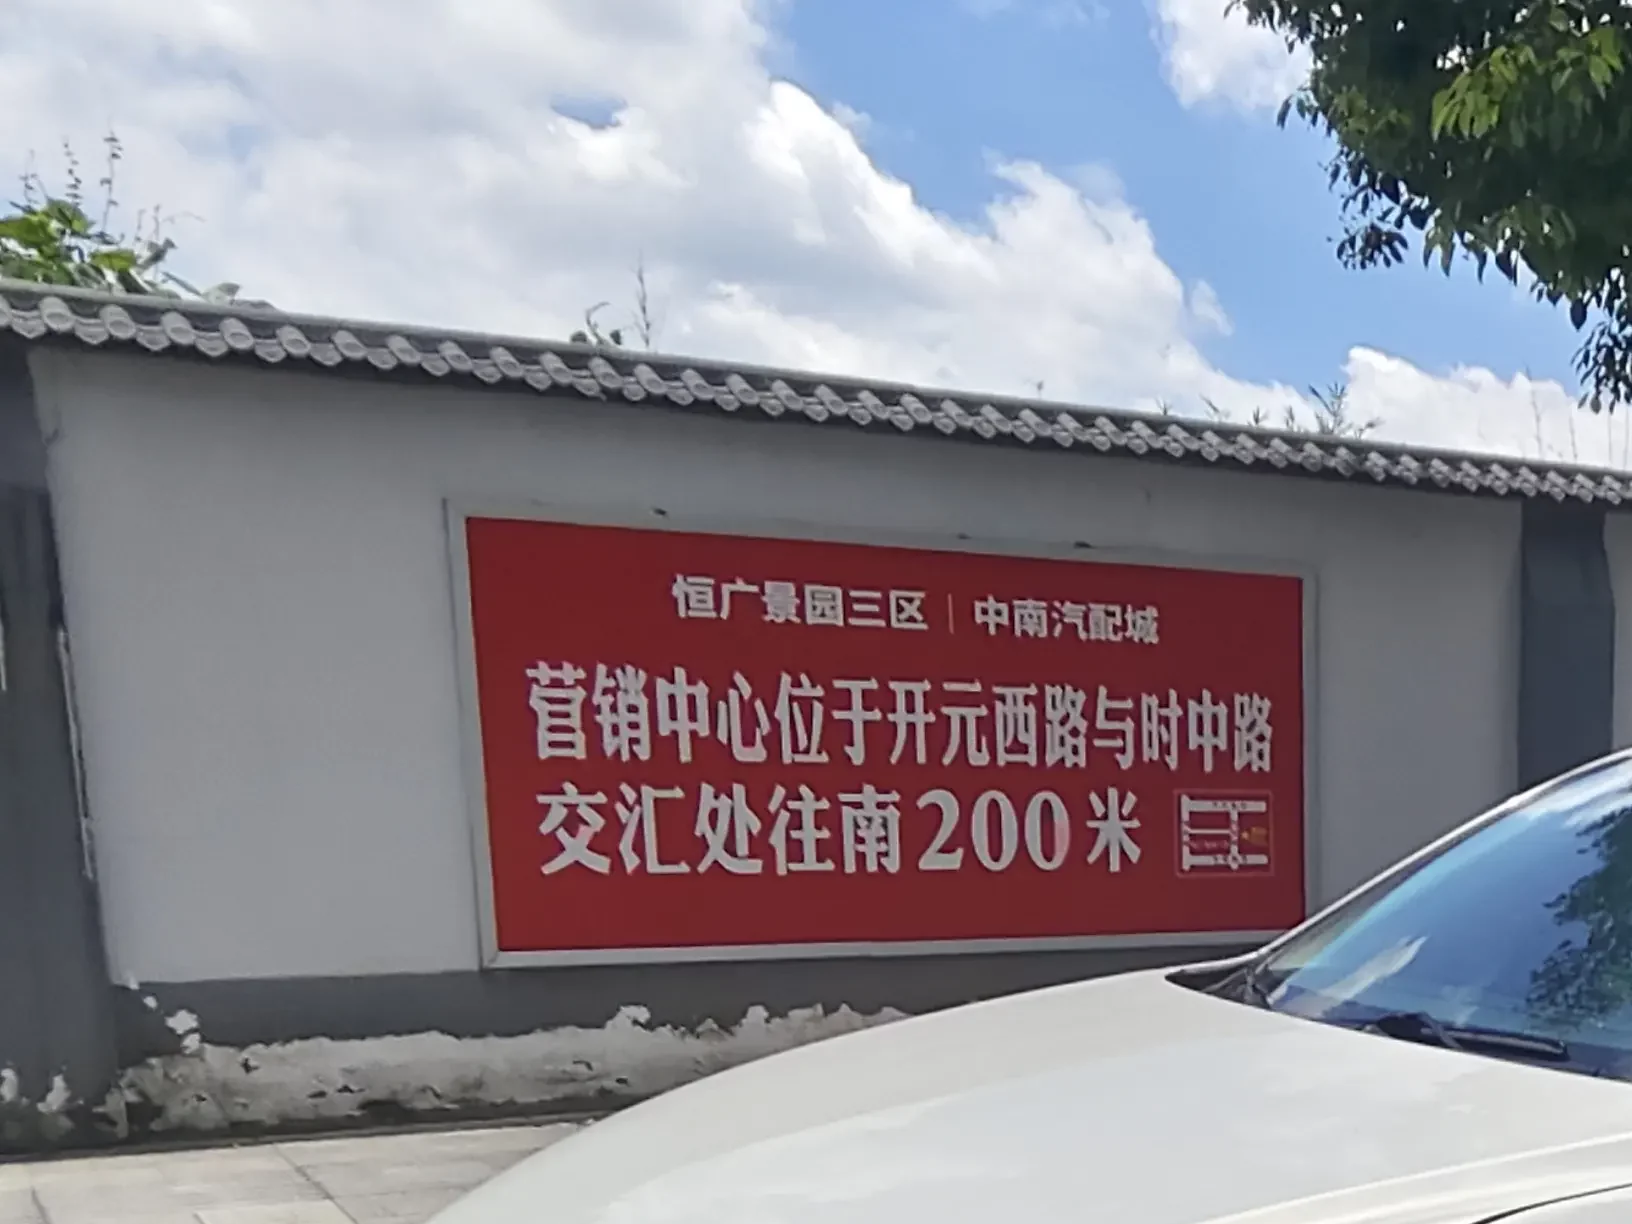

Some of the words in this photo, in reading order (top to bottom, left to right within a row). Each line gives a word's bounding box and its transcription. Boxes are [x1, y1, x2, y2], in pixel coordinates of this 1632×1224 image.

[671, 574, 929, 631] 恒广景园三区
[974, 596, 1160, 645] 中南汽配城
[525, 660, 1273, 773] 营销中心位于开元西路与时中路
[535, 781, 1142, 876] 交汇处往南200米
